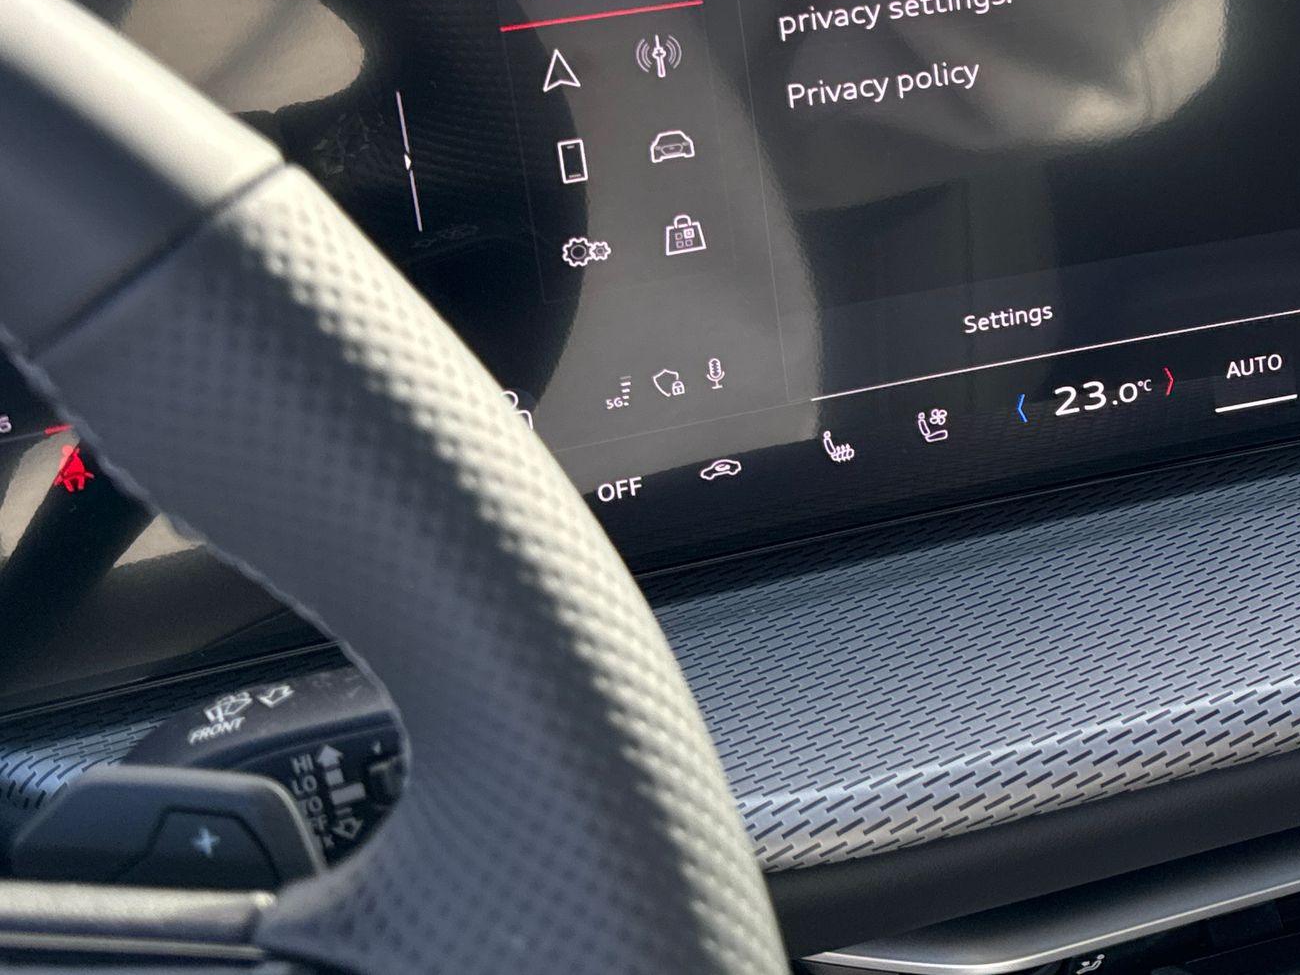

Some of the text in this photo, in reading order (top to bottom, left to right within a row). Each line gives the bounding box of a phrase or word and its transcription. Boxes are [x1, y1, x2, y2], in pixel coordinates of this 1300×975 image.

[779, 3, 880, 42] privacy
[787, 61, 980, 108] Privacy policy
[963, 302, 1053, 335] Settings
[1226, 353, 1282, 379] AUTO
[606, 397, 624, 410] 5G
[597, 476, 642, 502] OFF
[188, 717, 246, 745] FRONT
